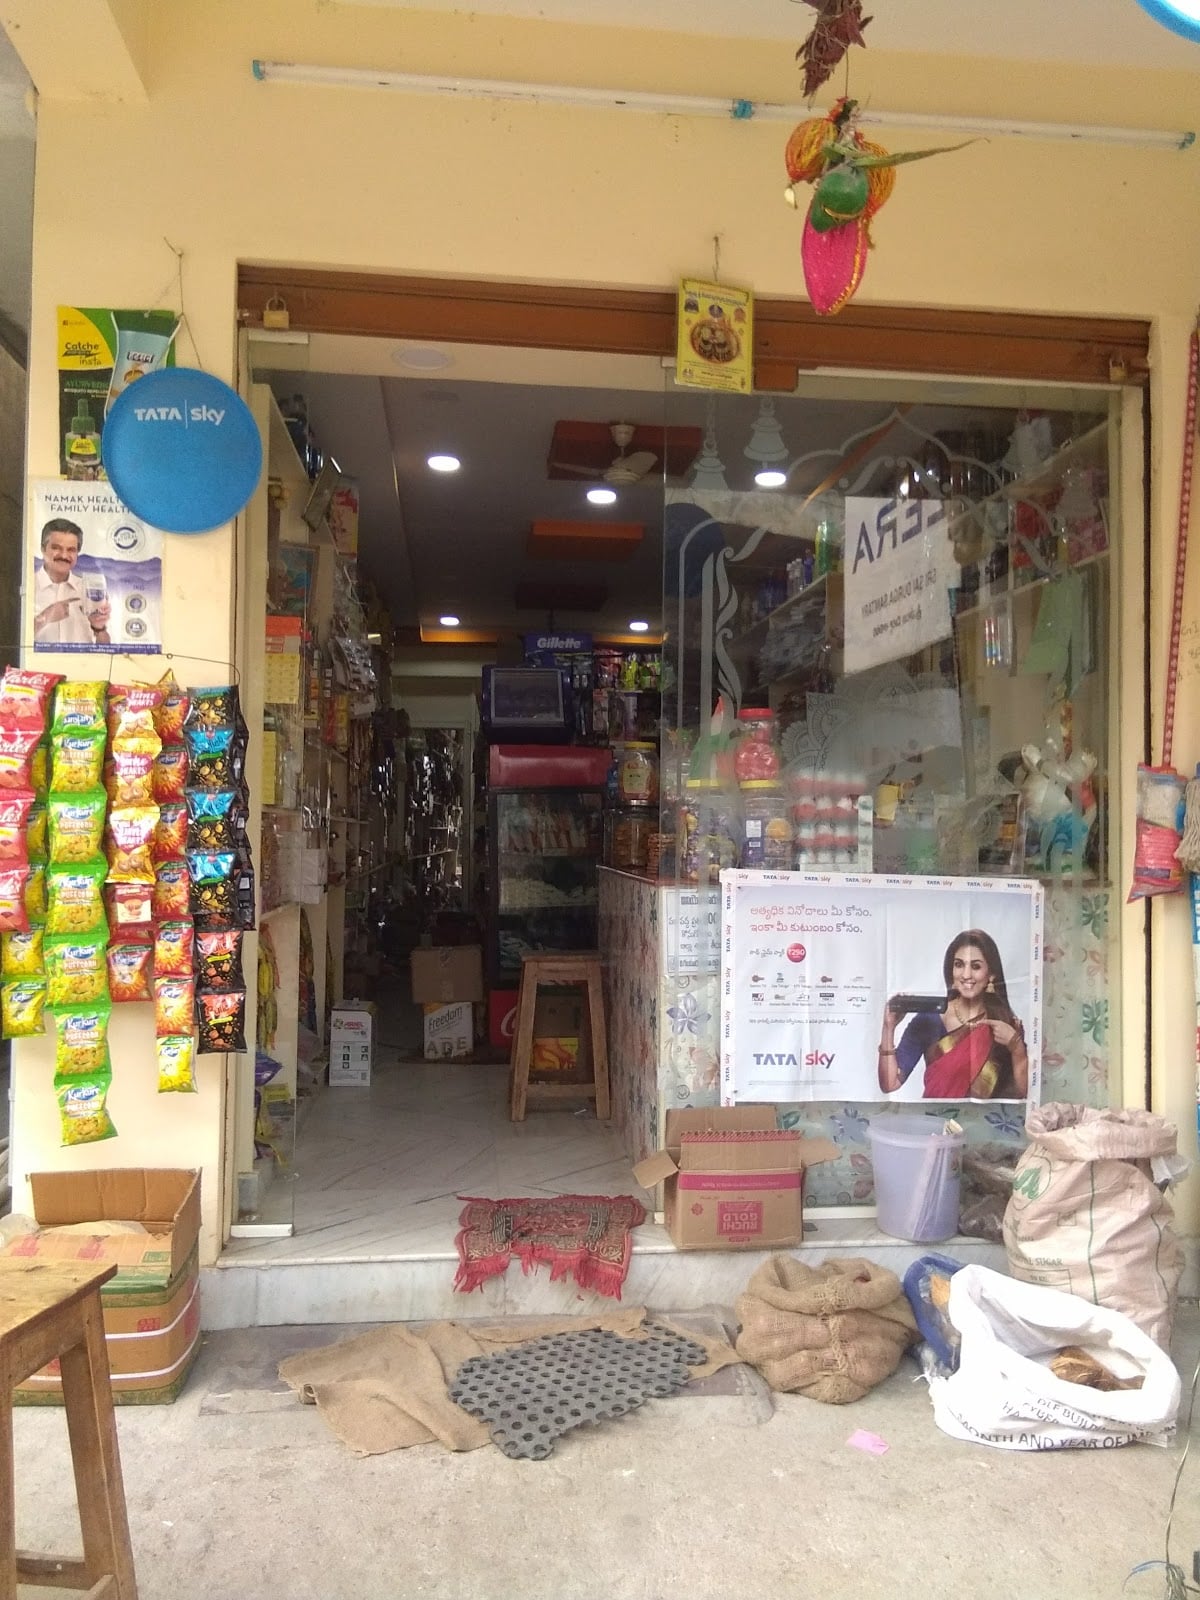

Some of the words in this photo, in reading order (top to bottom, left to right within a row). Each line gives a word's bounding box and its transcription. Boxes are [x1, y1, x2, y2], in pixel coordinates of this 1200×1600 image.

[134, 407, 182, 421] TATA
[191, 405, 225, 426] sky
[44, 495, 84, 503] NAMAK
[50, 504, 89, 513] FAMILY
[537, 637, 581, 649] Gillette
[428, 1006, 463, 1031] Freedom
[752, 1053, 798, 1066] TATA
[805, 1049, 836, 1070] sky
[723, 1212, 757, 1221] GOLD
[723, 1221, 757, 1230] RUCHI
[1035, 1257, 1063, 1266] SUGAR
[1018, 1433, 1055, 1450] AND
[1060, 1437, 1098, 1449] YEAR
[1103, 1436, 1123, 1449] OF
